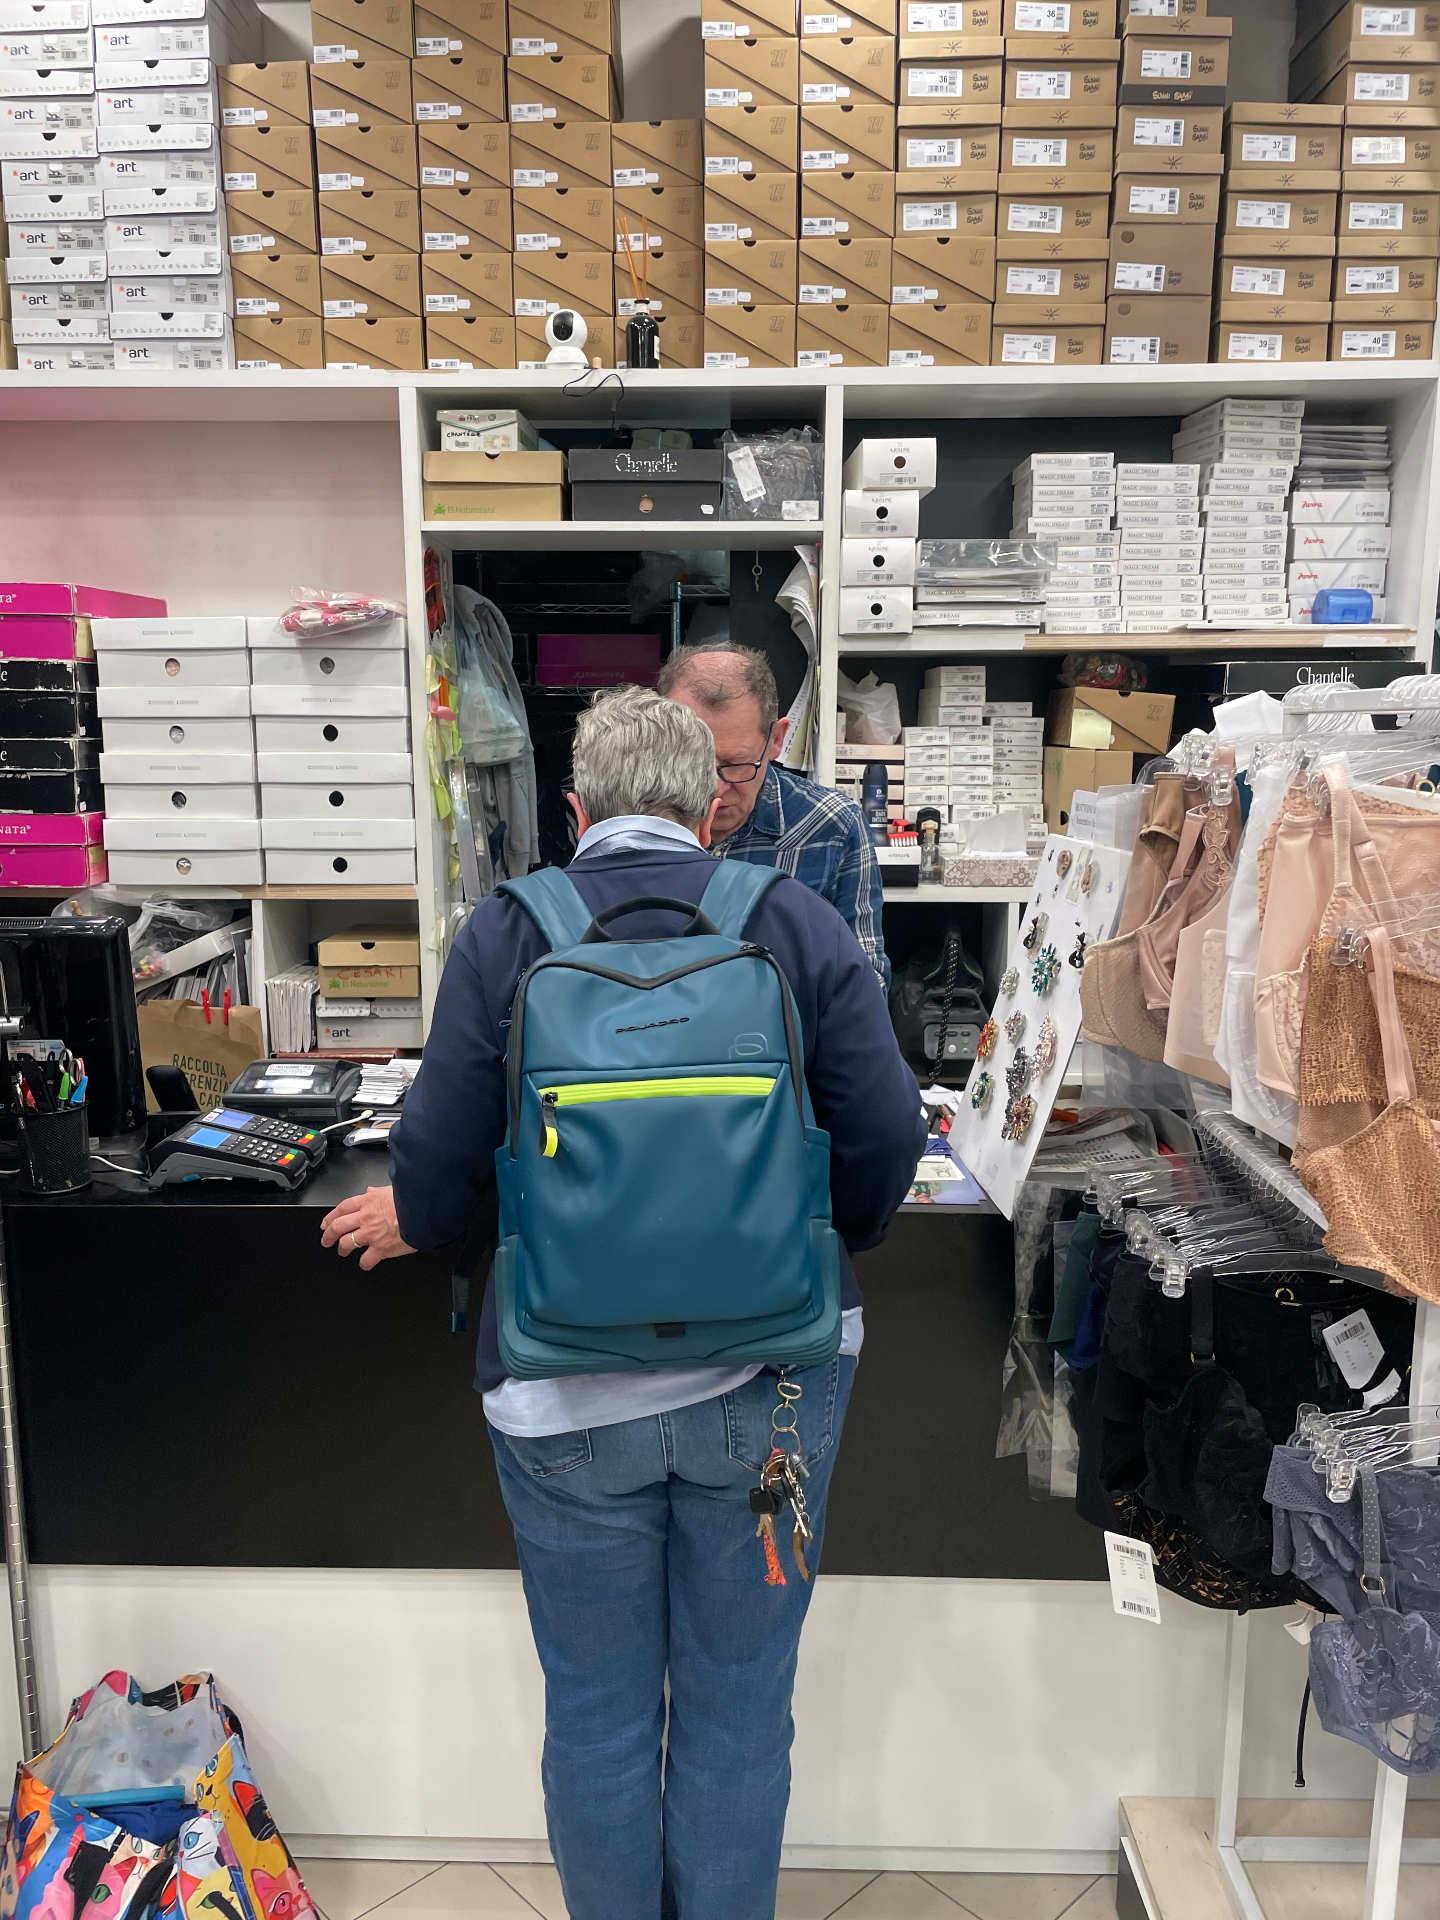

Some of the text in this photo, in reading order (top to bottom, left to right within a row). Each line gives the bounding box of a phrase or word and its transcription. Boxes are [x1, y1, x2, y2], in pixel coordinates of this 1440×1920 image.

[110, 35, 129, 45] art
[10, 45, 29, 55] art
[113, 98, 133, 108] art
[15, 109, 34, 119] art
[117, 162, 137, 172] art
[20, 171, 39, 180] art
[123, 226, 142, 235] art
[27, 234, 46, 243] art
[126, 287, 145, 296] art
[29, 295, 48, 305] art
[129, 348, 148, 358] art
[34, 360, 54, 369] art
[1302, 501, 1323, 509] Janira
[1304, 537, 1325, 545] Janira
[1297, 667, 1354, 684] Chantelle
[332, 1029, 350, 1037] art
[173, 1054, 226, 1078] RACCOLTA
